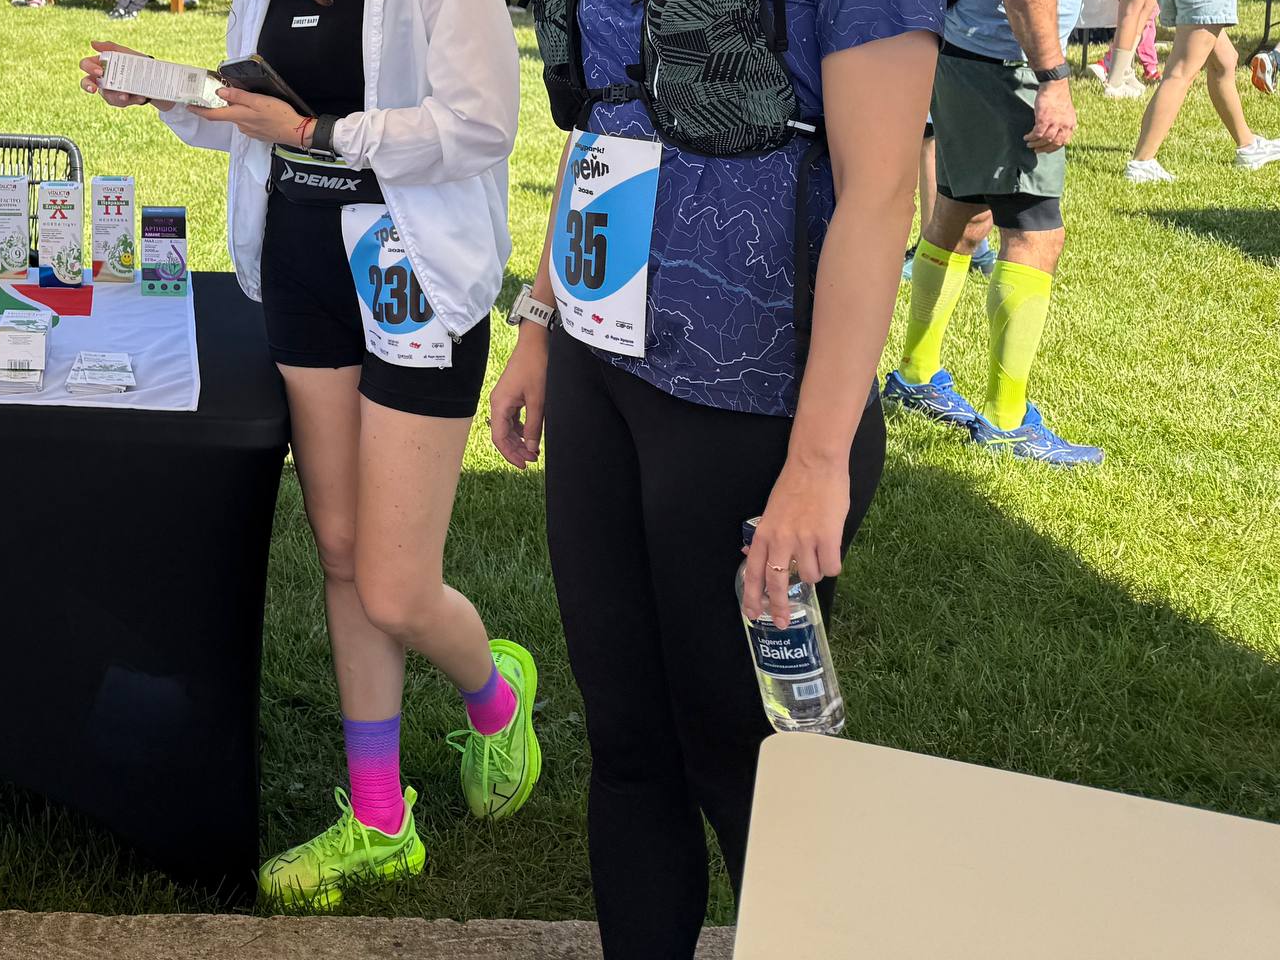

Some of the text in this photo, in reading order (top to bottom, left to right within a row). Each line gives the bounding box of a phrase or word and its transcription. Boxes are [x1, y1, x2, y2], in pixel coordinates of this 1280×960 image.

[294, 172, 363, 191] DEMIX
[565, 209, 609, 290] 35
[757, 636, 783, 646] Legend
[760, 644, 808, 660] Baikal
